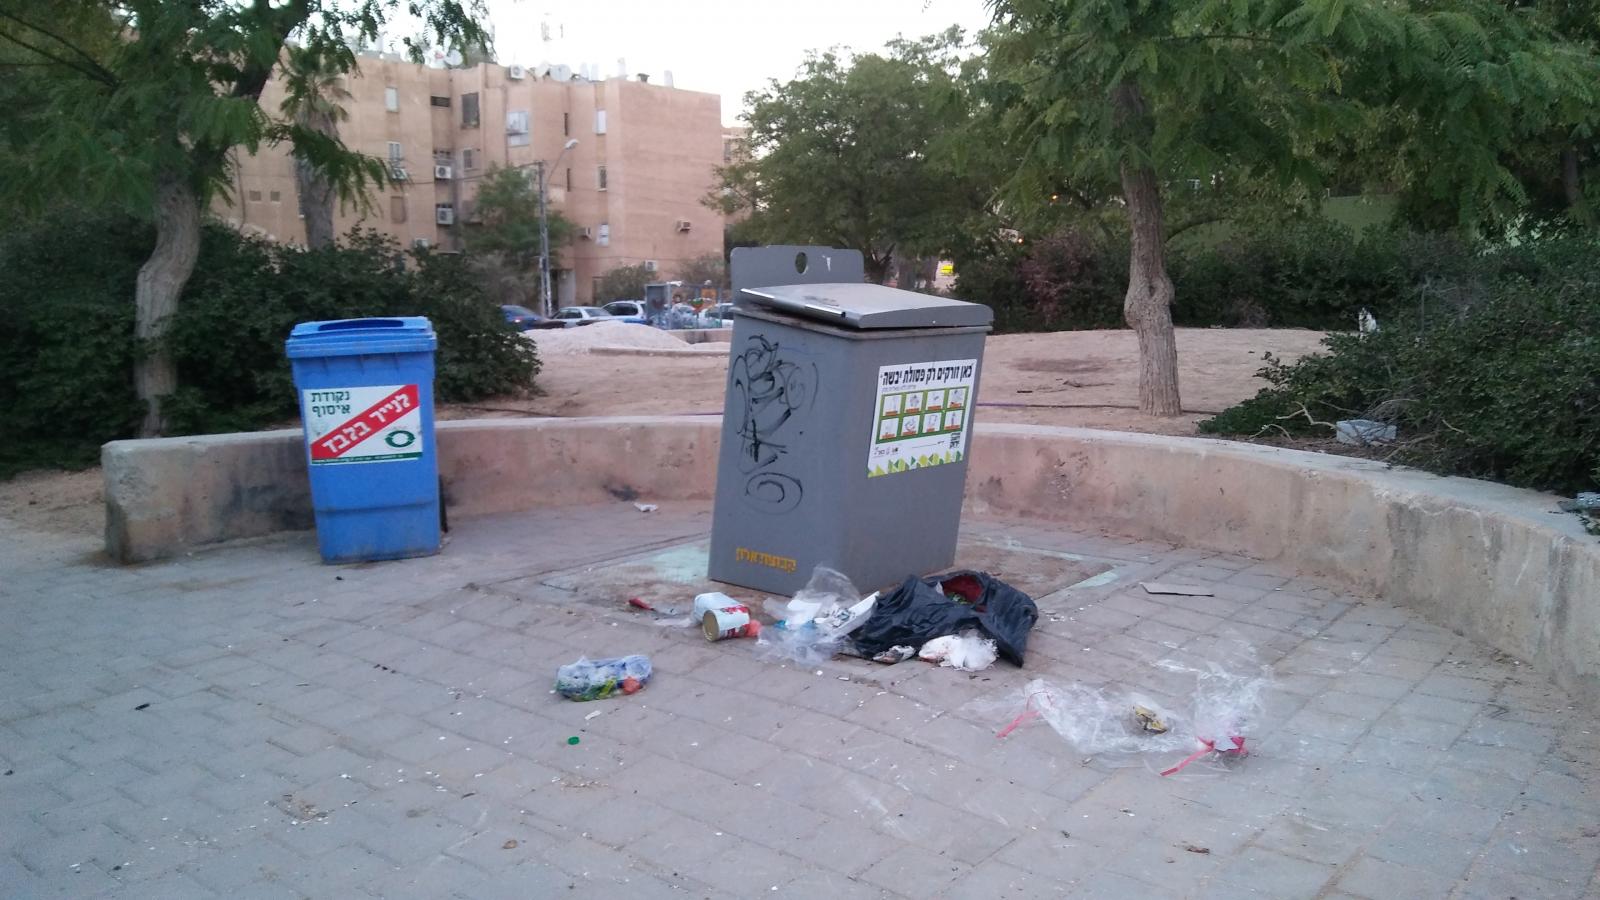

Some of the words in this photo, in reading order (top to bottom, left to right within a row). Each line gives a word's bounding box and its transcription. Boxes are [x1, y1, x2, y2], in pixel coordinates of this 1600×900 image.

[903, 366, 925, 383] פסולת
[925, 368, 936, 384] רק
[937, 366, 959, 383] זורקים
[960, 365, 972, 382] כאן
[311, 391, 350, 403] נקודת
[312, 404, 351, 417] איסוף
[369, 394, 410, 423] לנייר
[321, 421, 371, 453] בלבד
